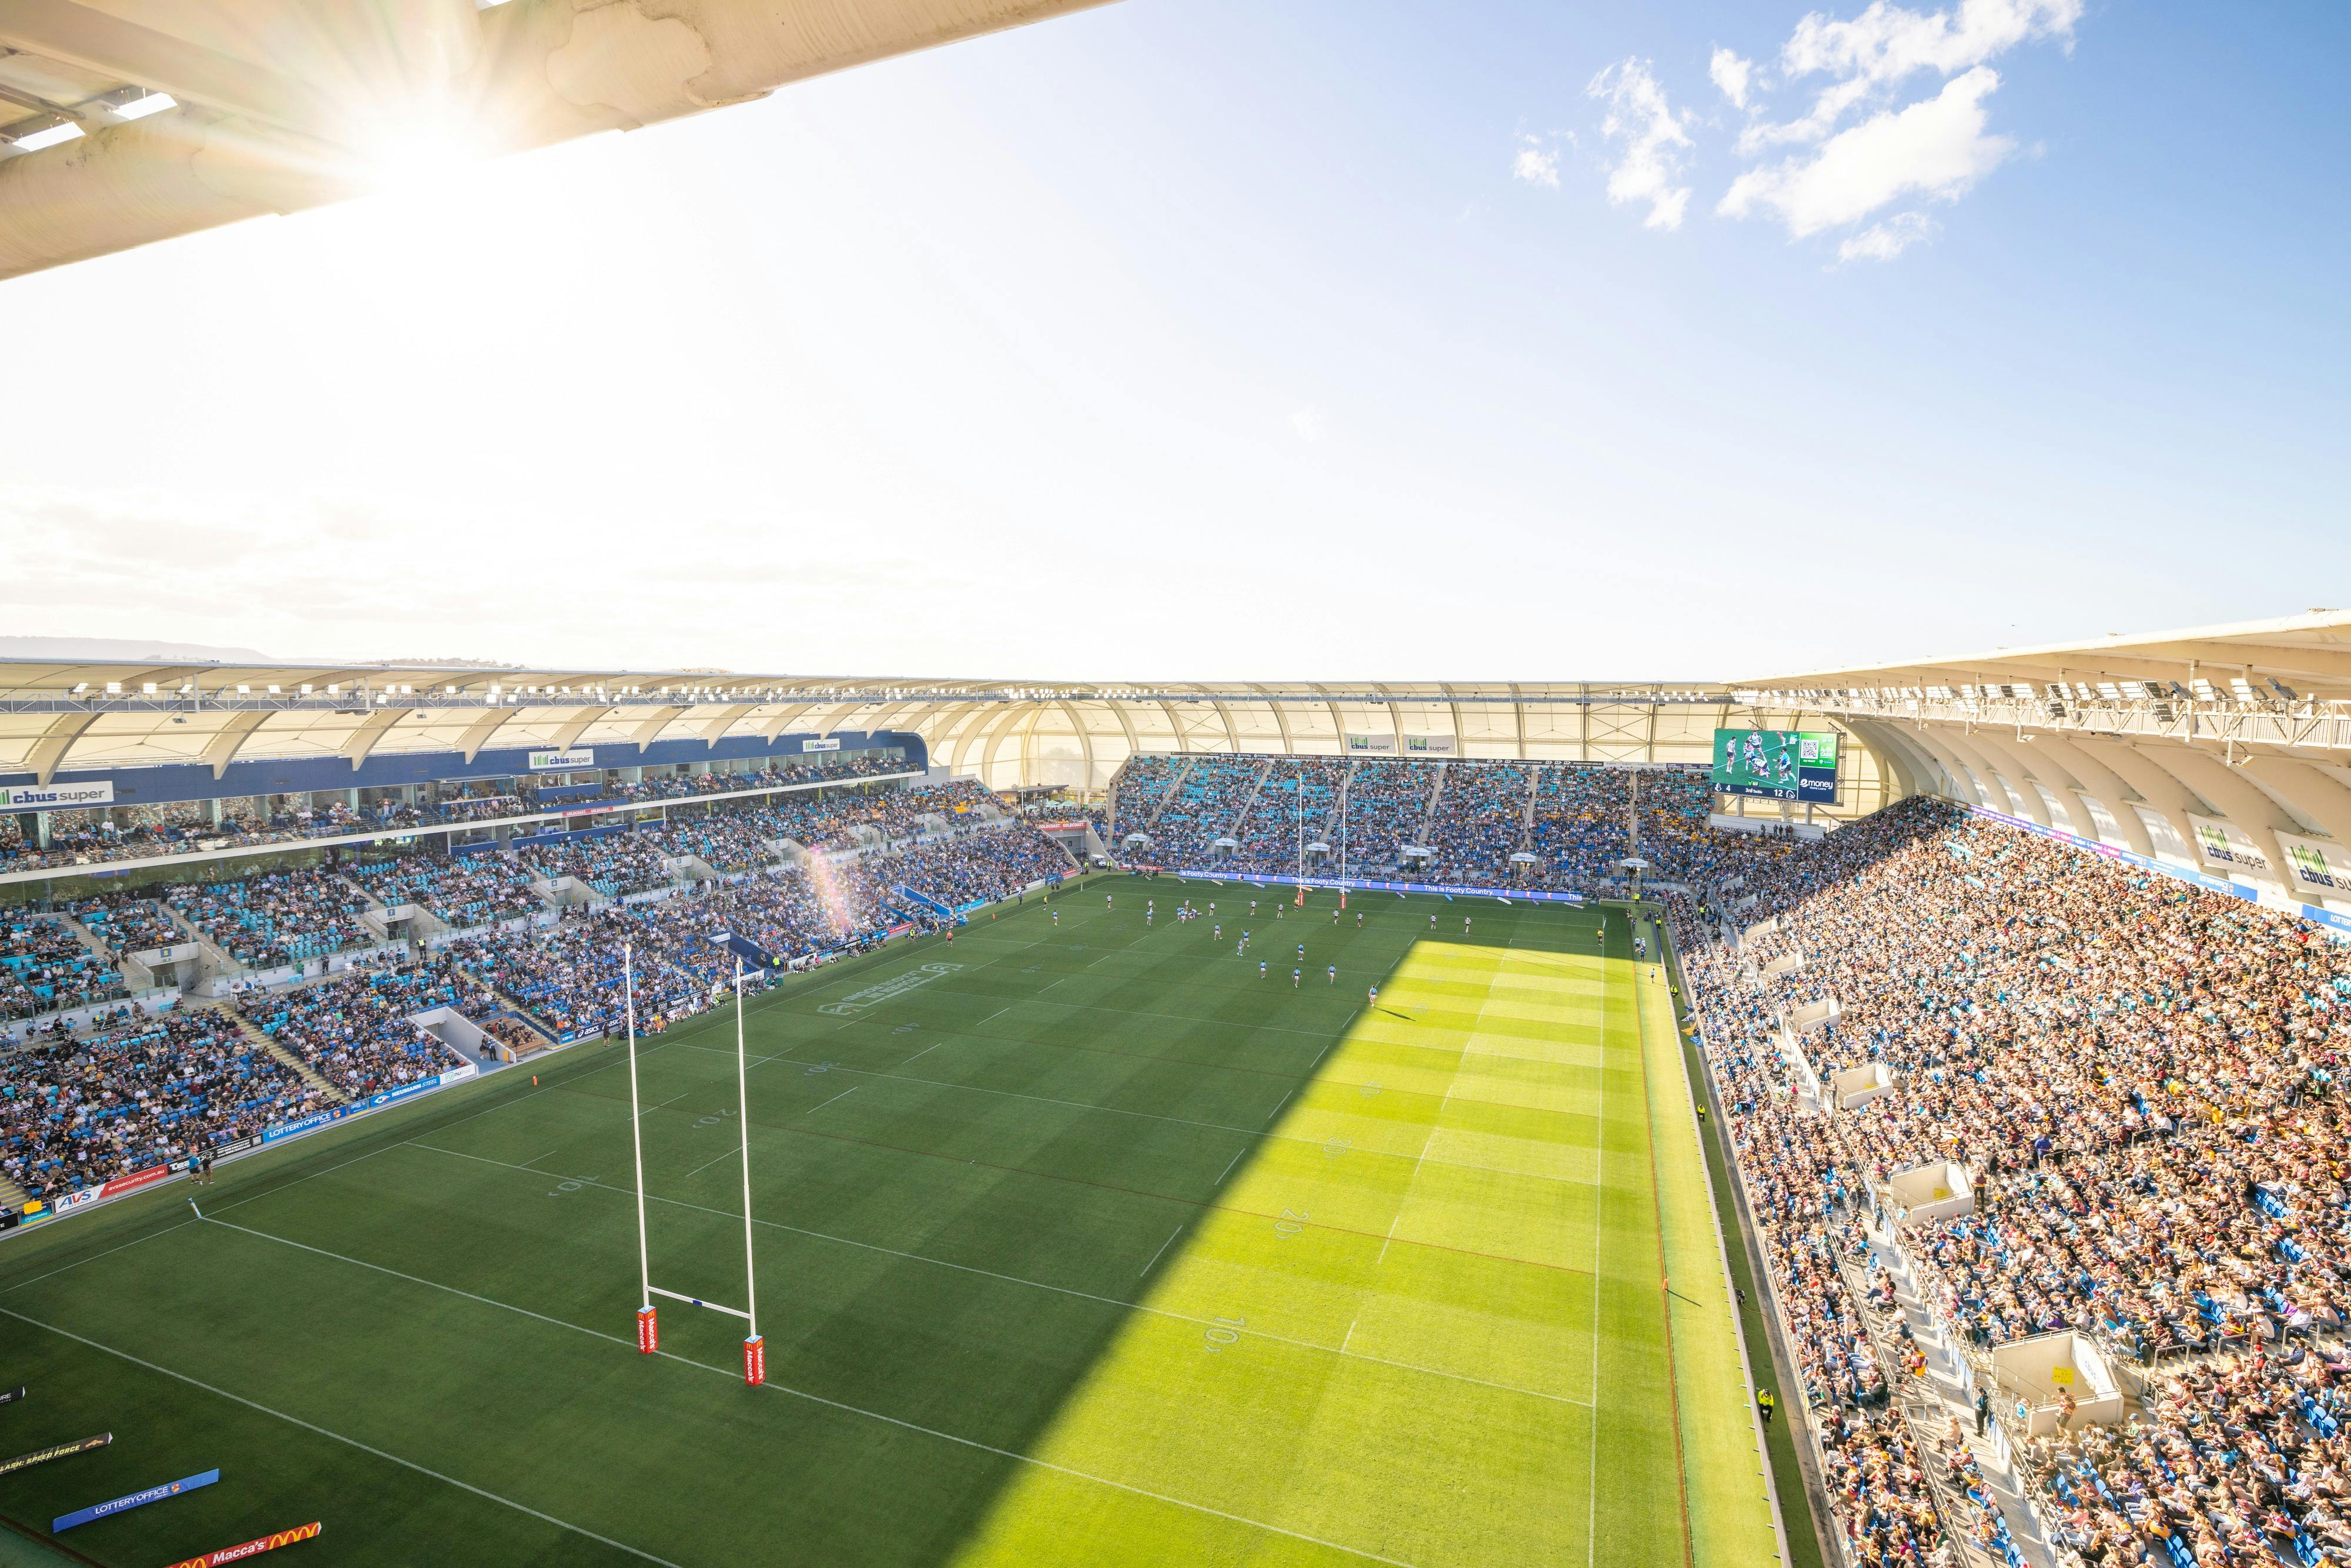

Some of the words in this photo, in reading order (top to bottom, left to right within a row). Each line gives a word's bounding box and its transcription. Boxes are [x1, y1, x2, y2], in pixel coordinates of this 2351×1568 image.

[13, 791, 57, 803] cbus
[59, 790, 105, 802] super
[2207, 843, 2233, 862] cbus
[2235, 852, 2266, 870] super
[2300, 865, 2334, 887] cbus
[1466, 888, 1494, 896] Country.
[2331, 914, 2351, 926] LOTTER
[585, 1025, 599, 1034] asics
[608, 1018, 620, 1027] asic
[391, 1084, 421, 1097] NEUMANN
[422, 1078, 437, 1087] STEEL
[108, 1168, 165, 1191] avssecurity.com.au
[59, 1190, 91, 1208] AVS
[26, 1452, 52, 1465] SPEED
[54, 1445, 80, 1456] FORCE
[213, 1540, 265, 1564] Macca's
